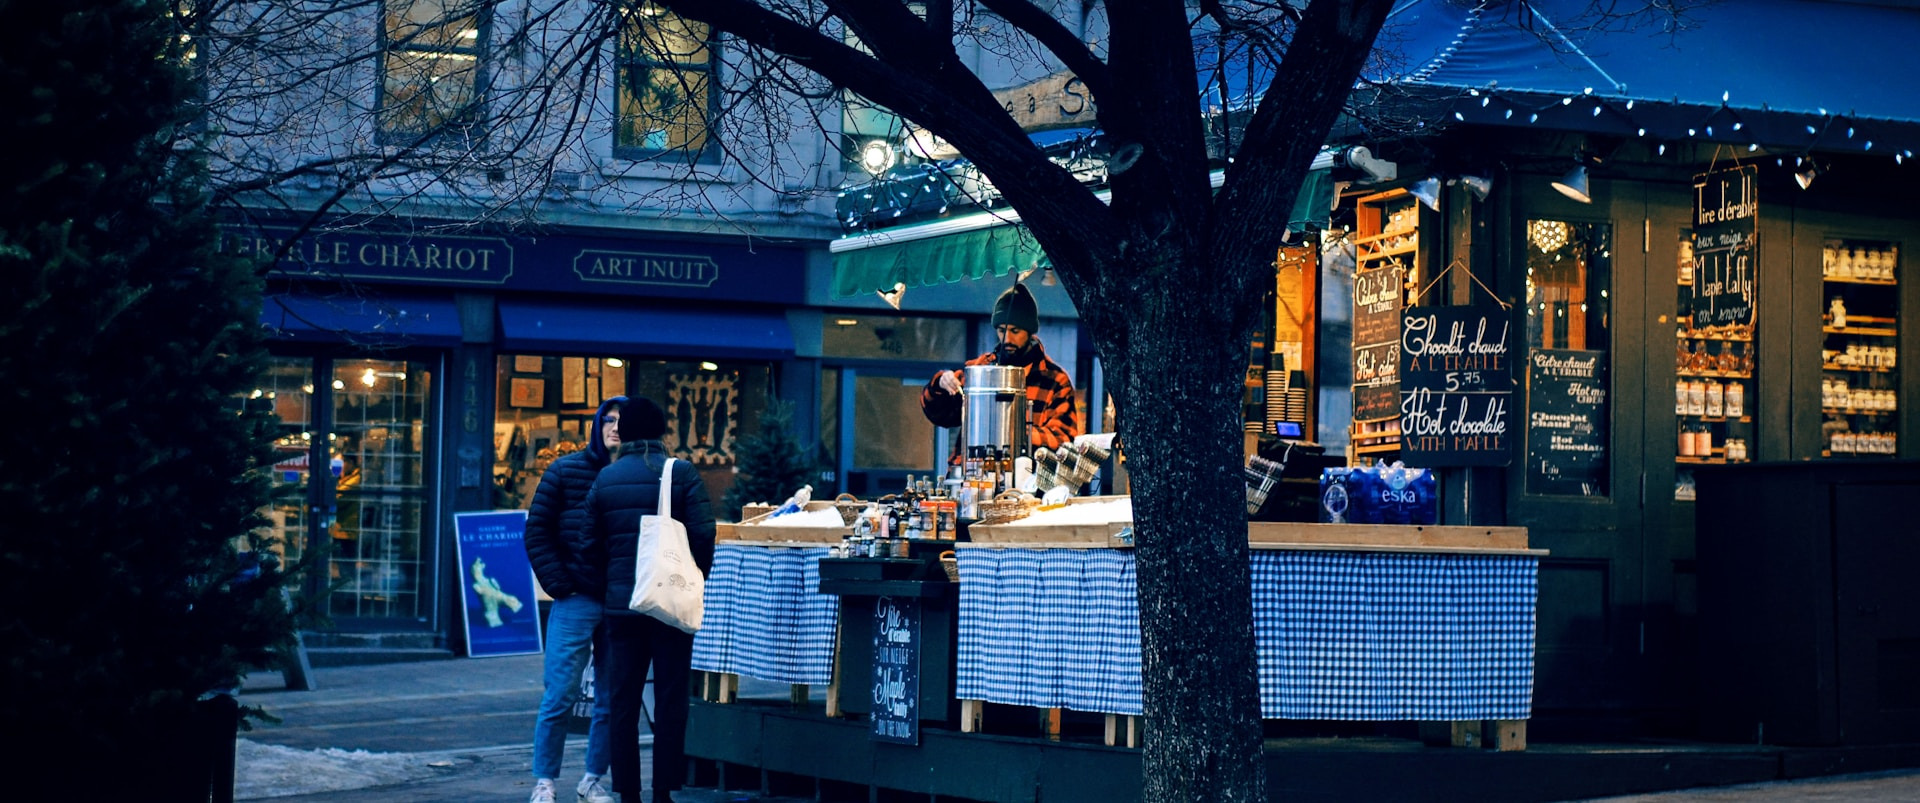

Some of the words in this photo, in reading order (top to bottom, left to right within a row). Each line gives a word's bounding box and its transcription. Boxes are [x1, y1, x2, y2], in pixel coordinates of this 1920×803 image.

[1693, 182, 1716, 226] Tire
[1717, 175, 1757, 223] d'érable
[1697, 236, 1714, 249] sur
[314, 241, 351, 265] LE
[360, 243, 496, 272] CHARIOT
[591, 257, 637, 277] ART
[644, 259, 708, 280] INUIT
[1691, 254, 1723, 316] Maple
[1698, 309, 1712, 323] on
[1718, 306, 1748, 321] snow
[1403, 314, 1466, 358] Chocolat
[1469, 317, 1508, 356] chaud
[1401, 386, 1448, 437] Hot
[1449, 396, 1506, 436] chocolate
[1406, 436, 1446, 451] WITH
[1454, 435, 1505, 452] MAPLE
[1382, 488, 1416, 503] eska
